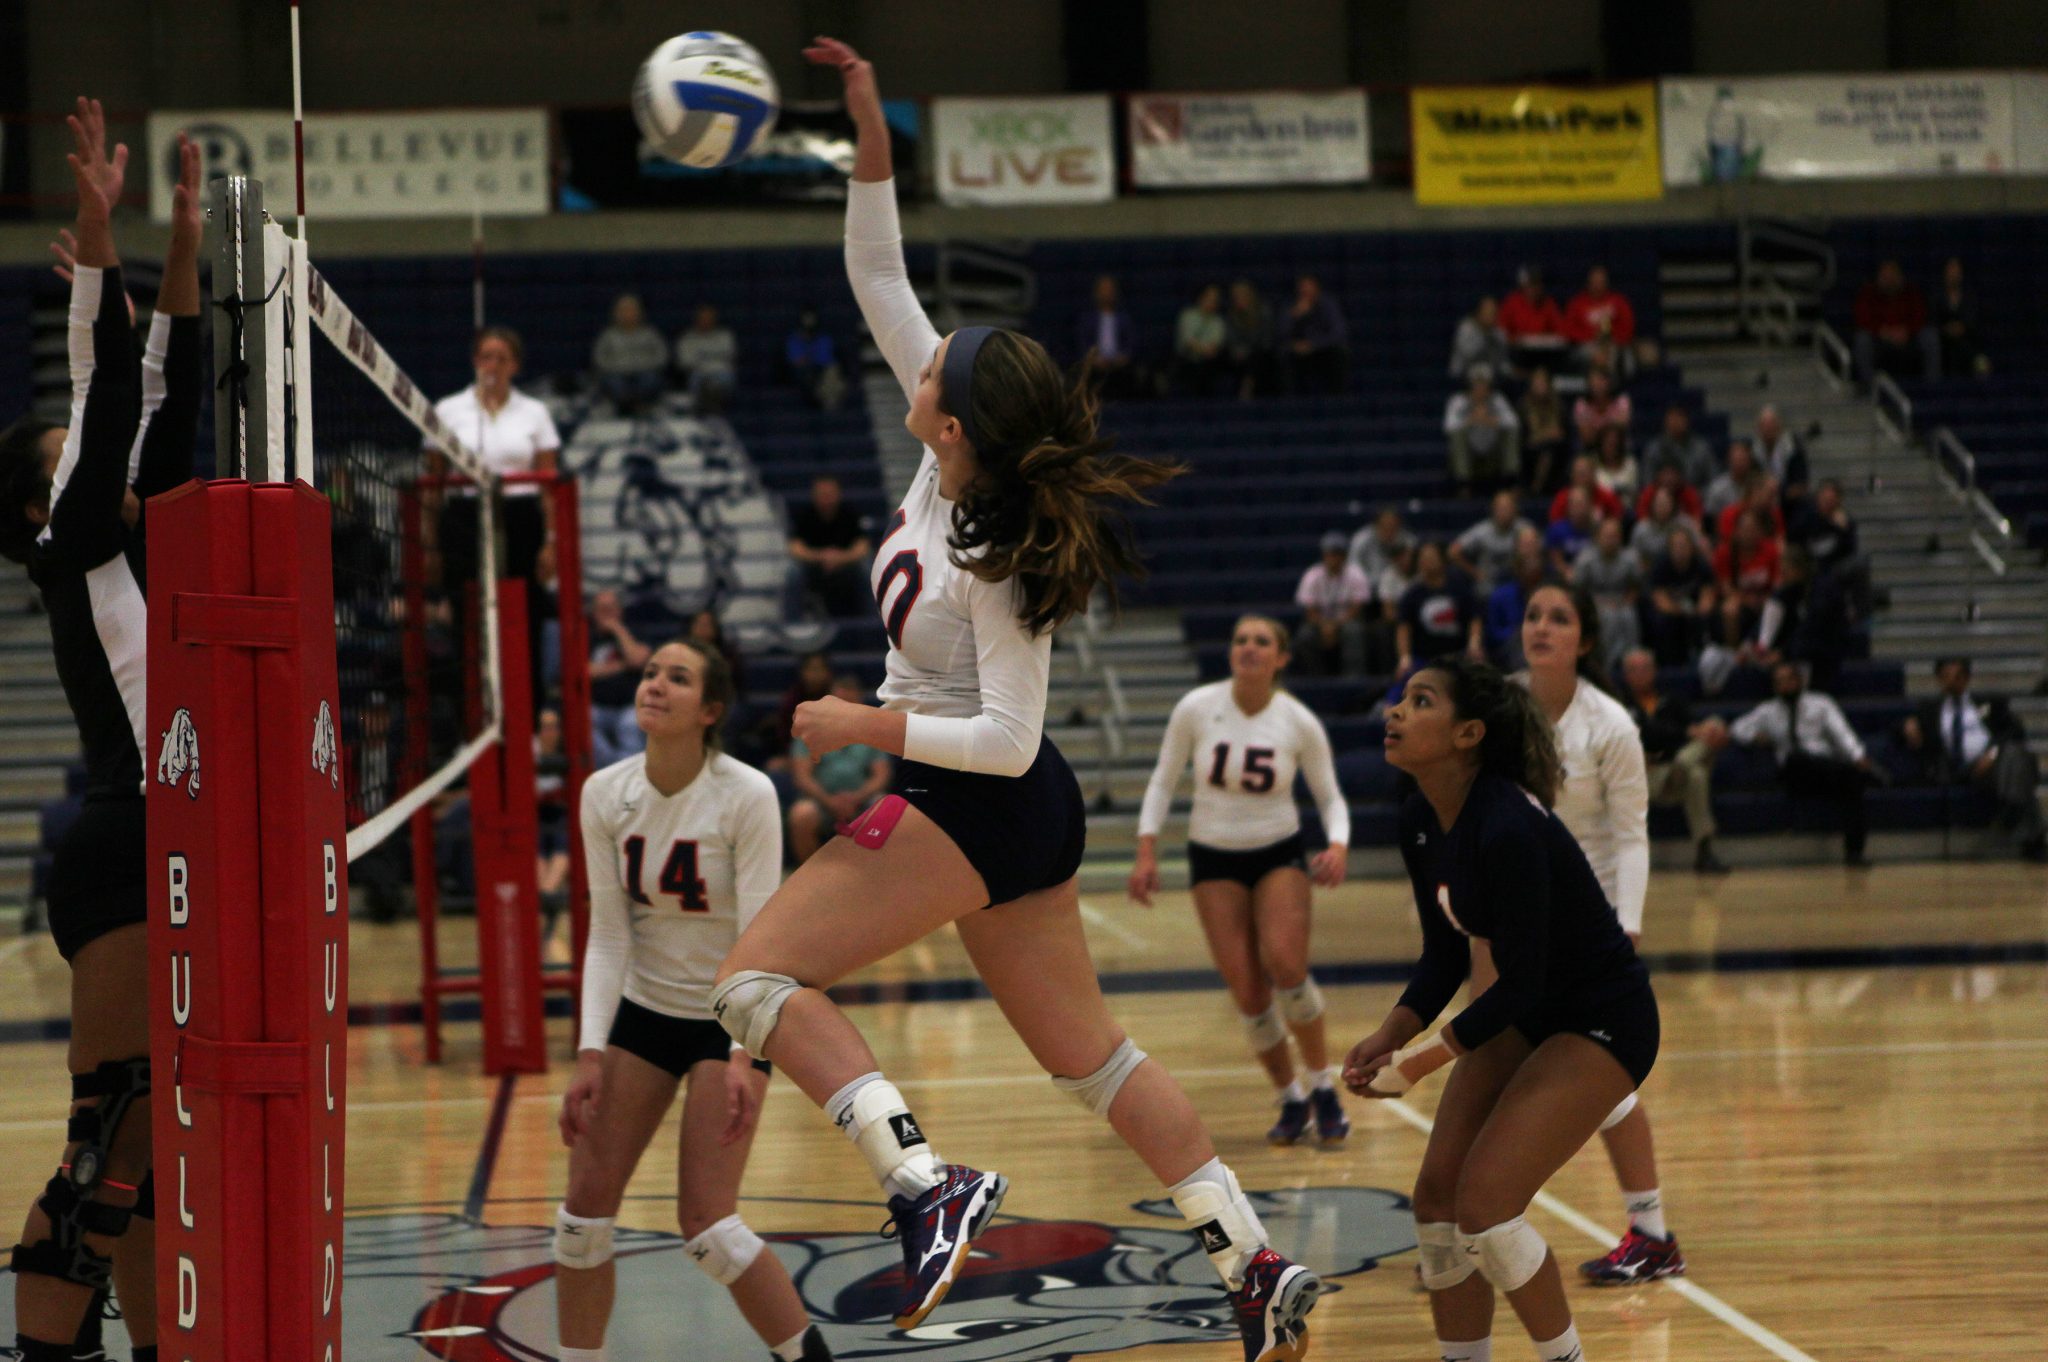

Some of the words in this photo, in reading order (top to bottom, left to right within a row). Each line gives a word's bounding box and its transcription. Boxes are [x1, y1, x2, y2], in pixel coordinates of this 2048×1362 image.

[264, 128, 534, 164] BELLEVUE
[949, 147, 1097, 187] LIVE
[1208, 741, 1276, 794] 15
[623, 834, 710, 913] 14
[167, 853, 197, 1362] BULLD
[323, 841, 338, 1362] BULLD
